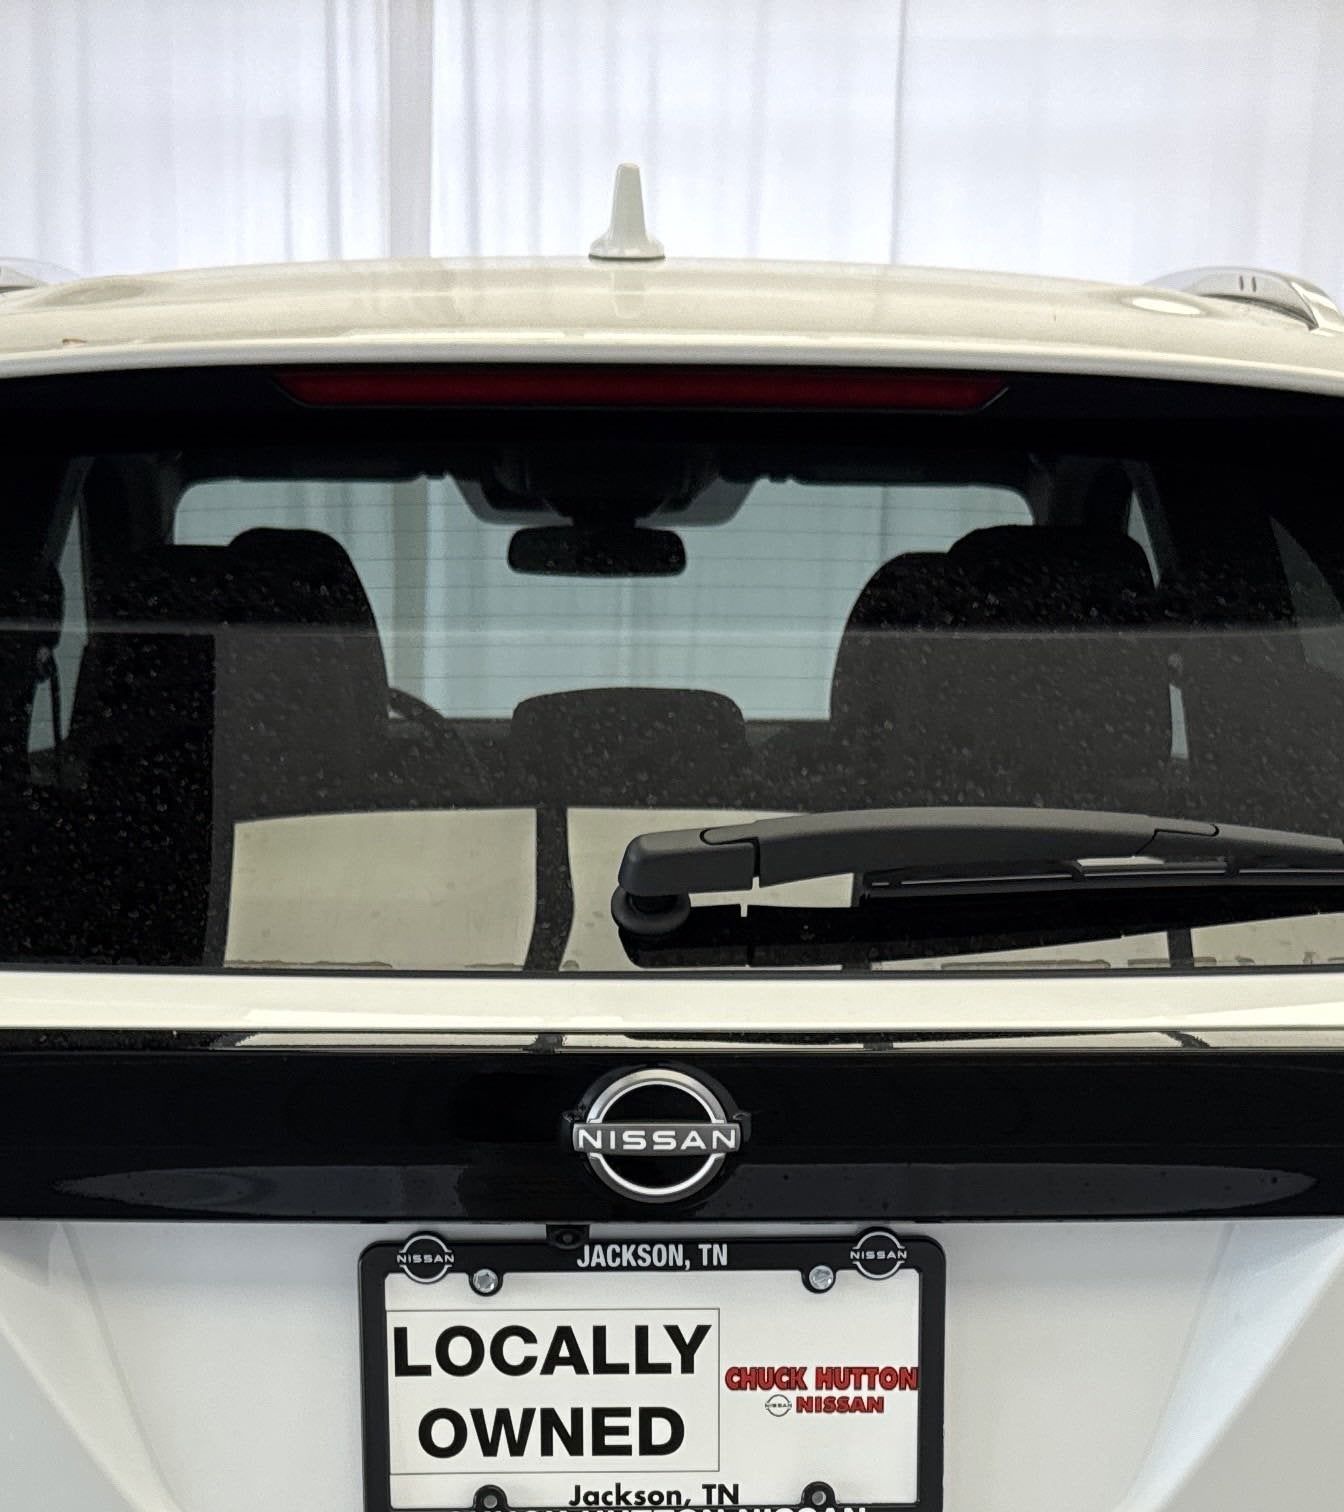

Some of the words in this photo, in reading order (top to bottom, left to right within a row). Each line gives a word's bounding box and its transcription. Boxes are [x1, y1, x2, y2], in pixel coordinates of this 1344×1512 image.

[577, 1129, 736, 1151] NISSAN
[397, 1253, 455, 1264] NISSAN
[577, 1244, 691, 1271] JACKSON,
[698, 1243, 728, 1267] TN
[850, 1249, 907, 1261] NISSAN
[393, 1325, 712, 1377] LOCALLY
[724, 1366, 808, 1391] CHUCK
[814, 1366, 920, 1391] HUTTON
[796, 1395, 885, 1414] NISSAN
[417, 1407, 686, 1458] OWNED
[568, 1483, 692, 1508] Jackson,
[701, 1483, 740, 1505] TN
